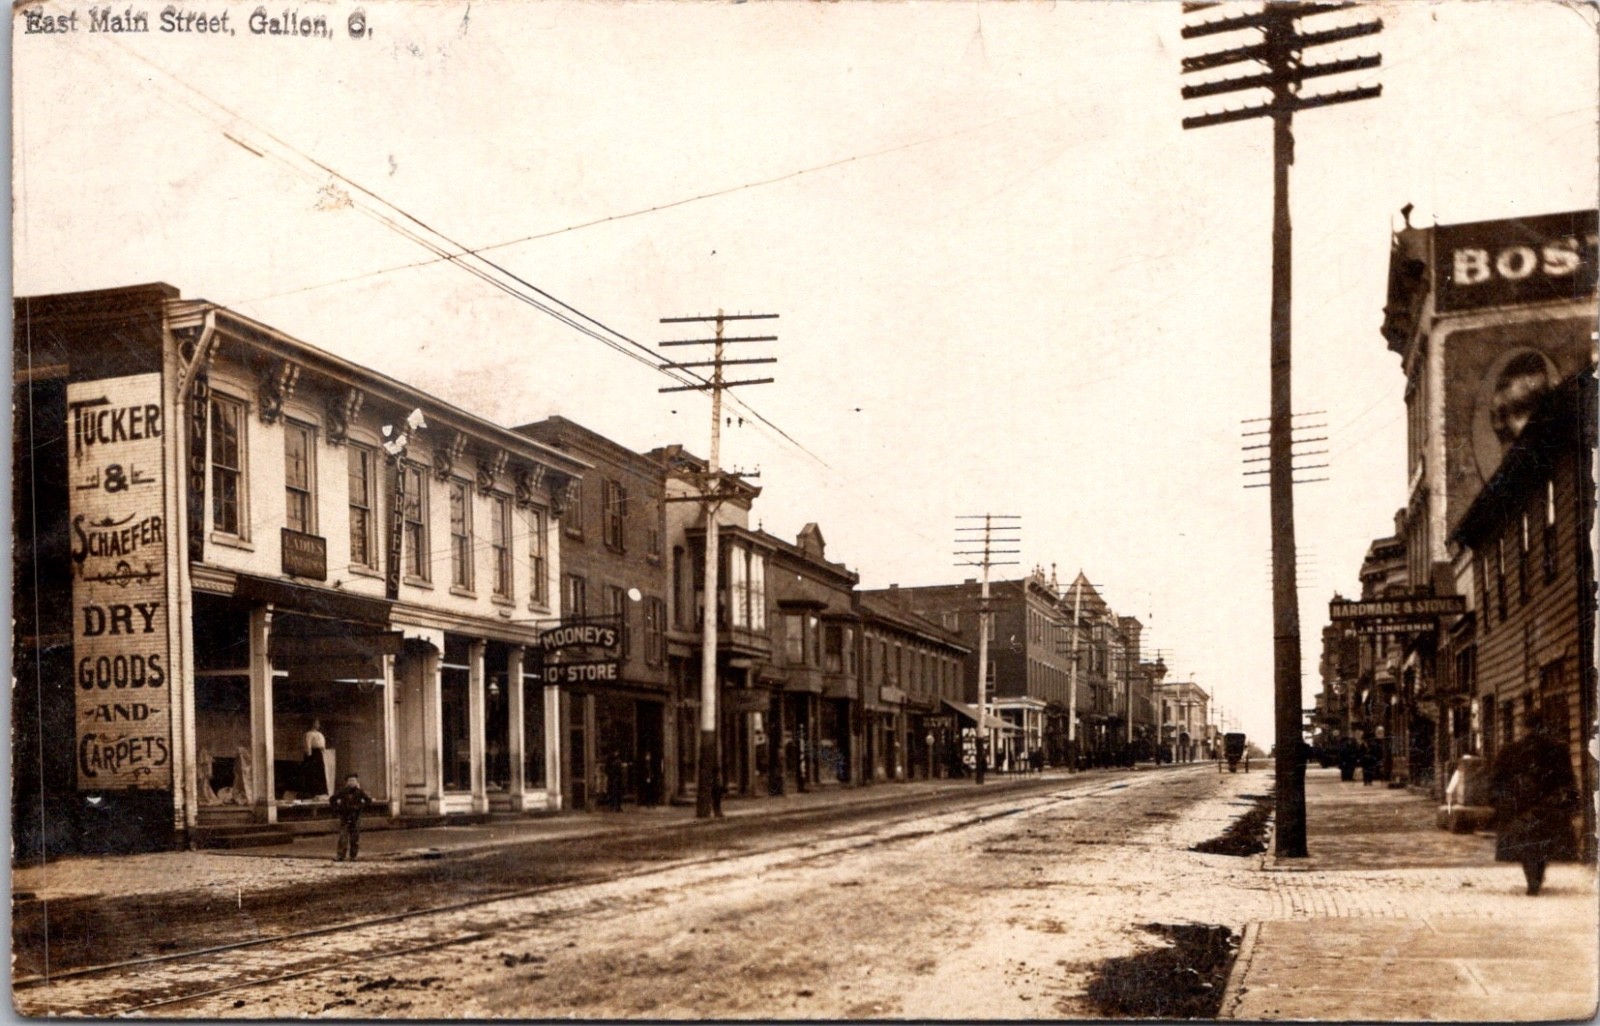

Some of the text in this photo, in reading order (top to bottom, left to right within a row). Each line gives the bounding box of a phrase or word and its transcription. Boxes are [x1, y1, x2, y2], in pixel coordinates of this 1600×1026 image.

[69, 395, 162, 463] TUCKER
[104, 464, 128, 493] &
[72, 515, 163, 567] SCHAEFER
[389, 456, 406, 591] CARPETS
[82, 602, 160, 637] DRY
[1332, 599, 1463, 617] HARDWARE & STOVES
[542, 626, 615, 650] MOONEY'S
[79, 654, 165, 690] GOODS
[567, 663, 617, 681] STORE
[79, 733, 168, 778] CARPETS
